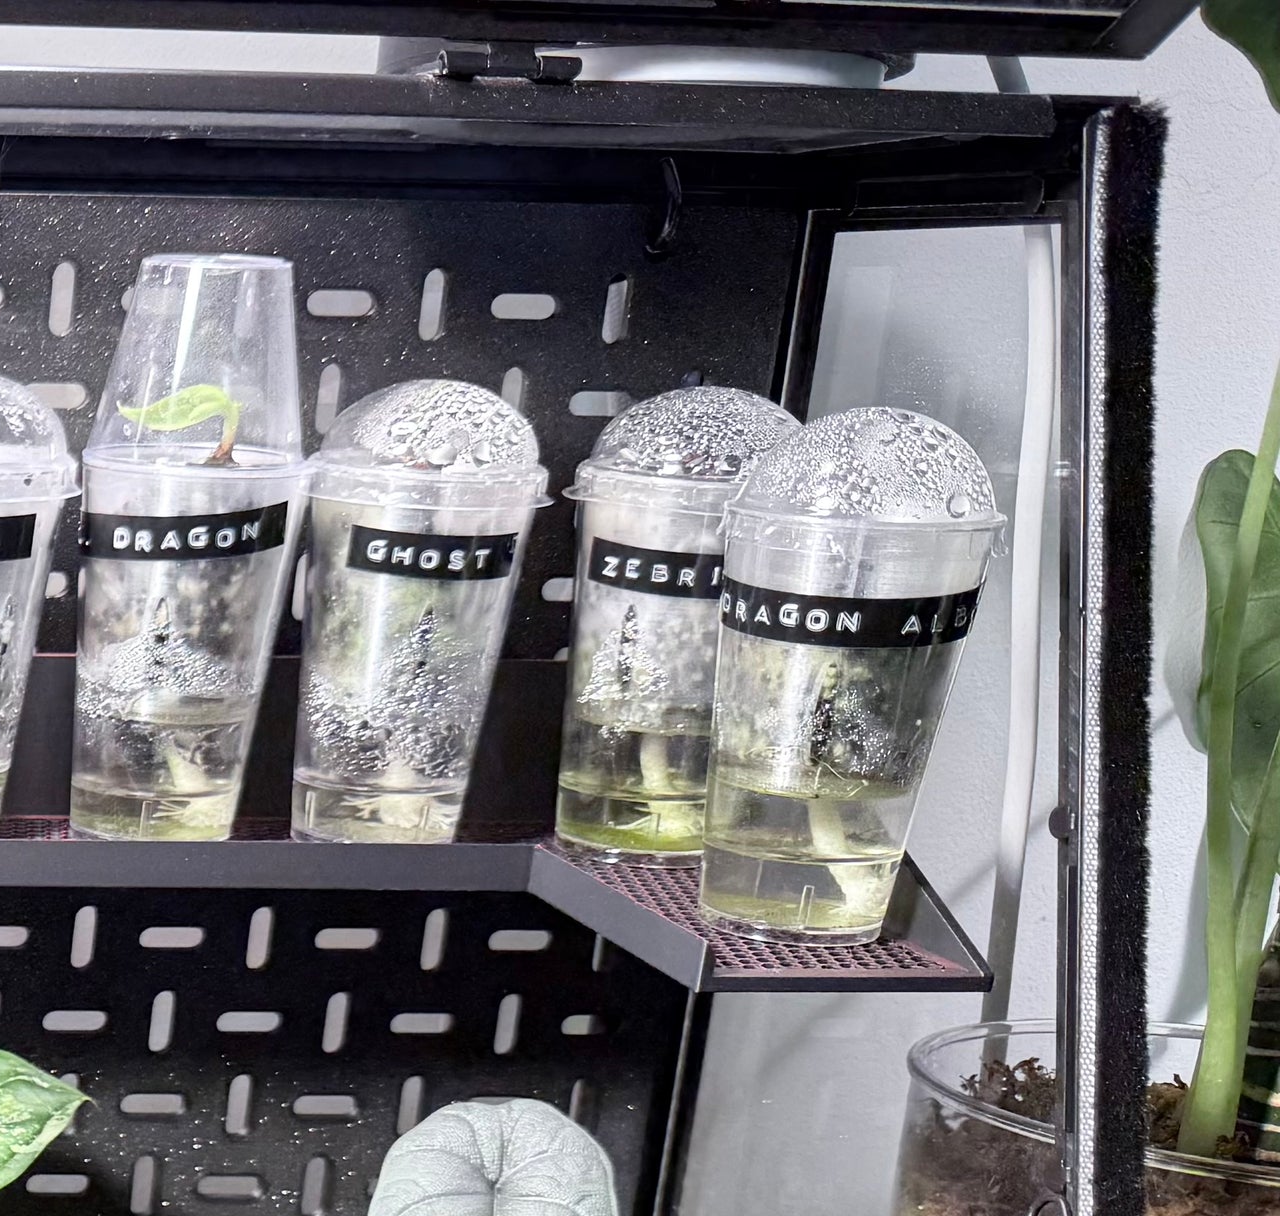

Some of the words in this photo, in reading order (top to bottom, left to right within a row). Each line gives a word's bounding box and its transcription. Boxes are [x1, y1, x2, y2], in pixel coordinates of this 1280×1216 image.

[112, 520, 260, 554] DRAGON
[366, 539, 493, 572] GHOST
[602, 555, 724, 588] ZEBRI
